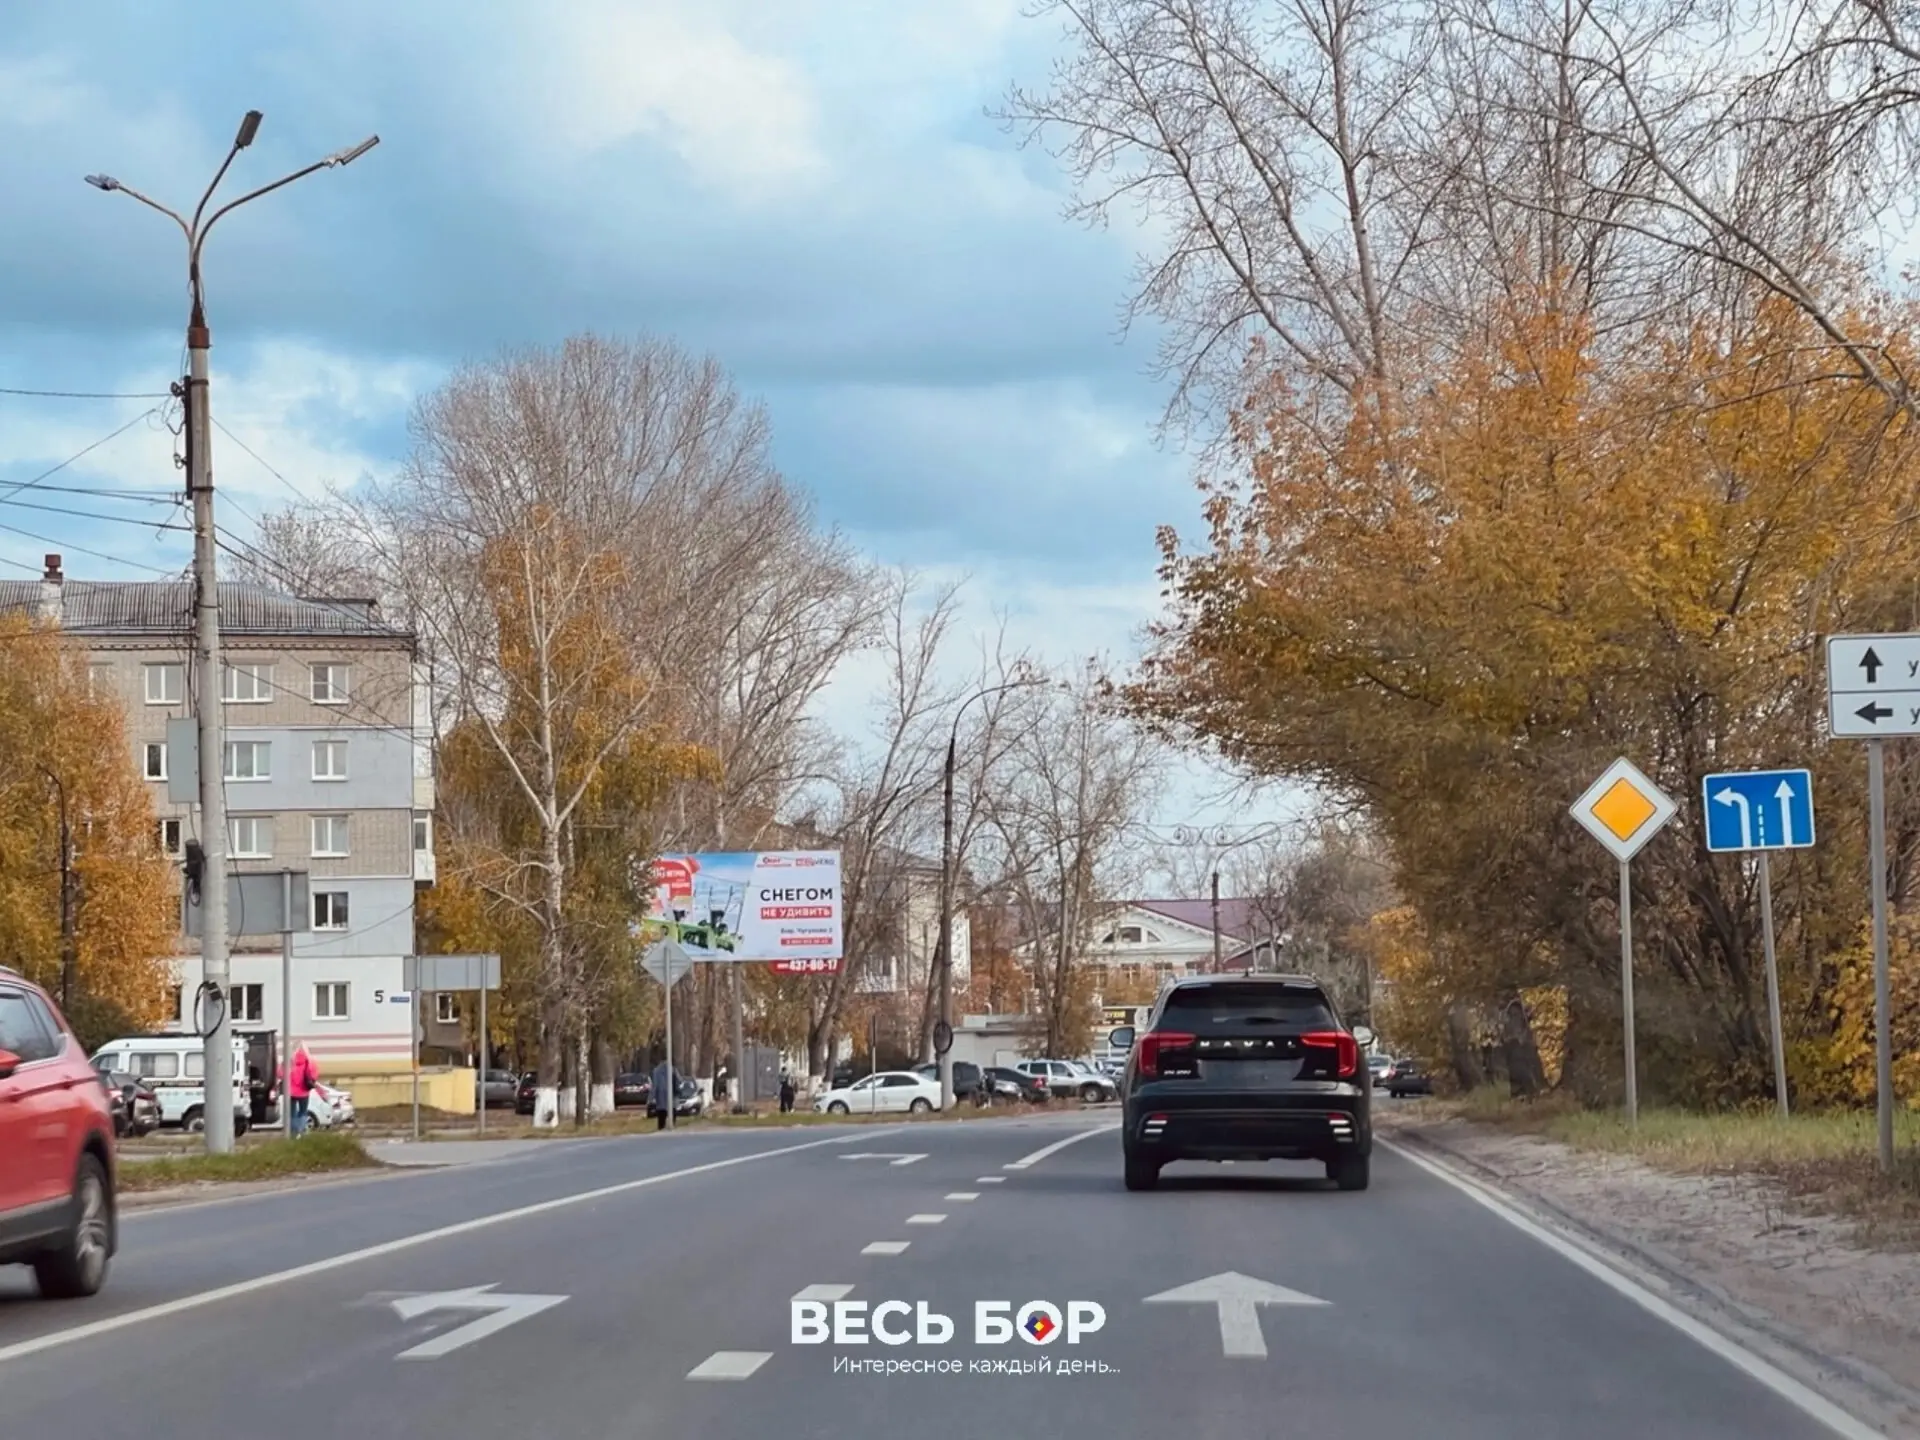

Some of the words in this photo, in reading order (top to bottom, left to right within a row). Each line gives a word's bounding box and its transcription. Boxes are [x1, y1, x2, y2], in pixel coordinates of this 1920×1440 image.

[760, 888, 833, 901] СНЕГОМ
[762, 907, 777, 918] НЕ
[779, 906, 831, 919] УДИВИТЬ
[374, 989, 385, 1004] 5
